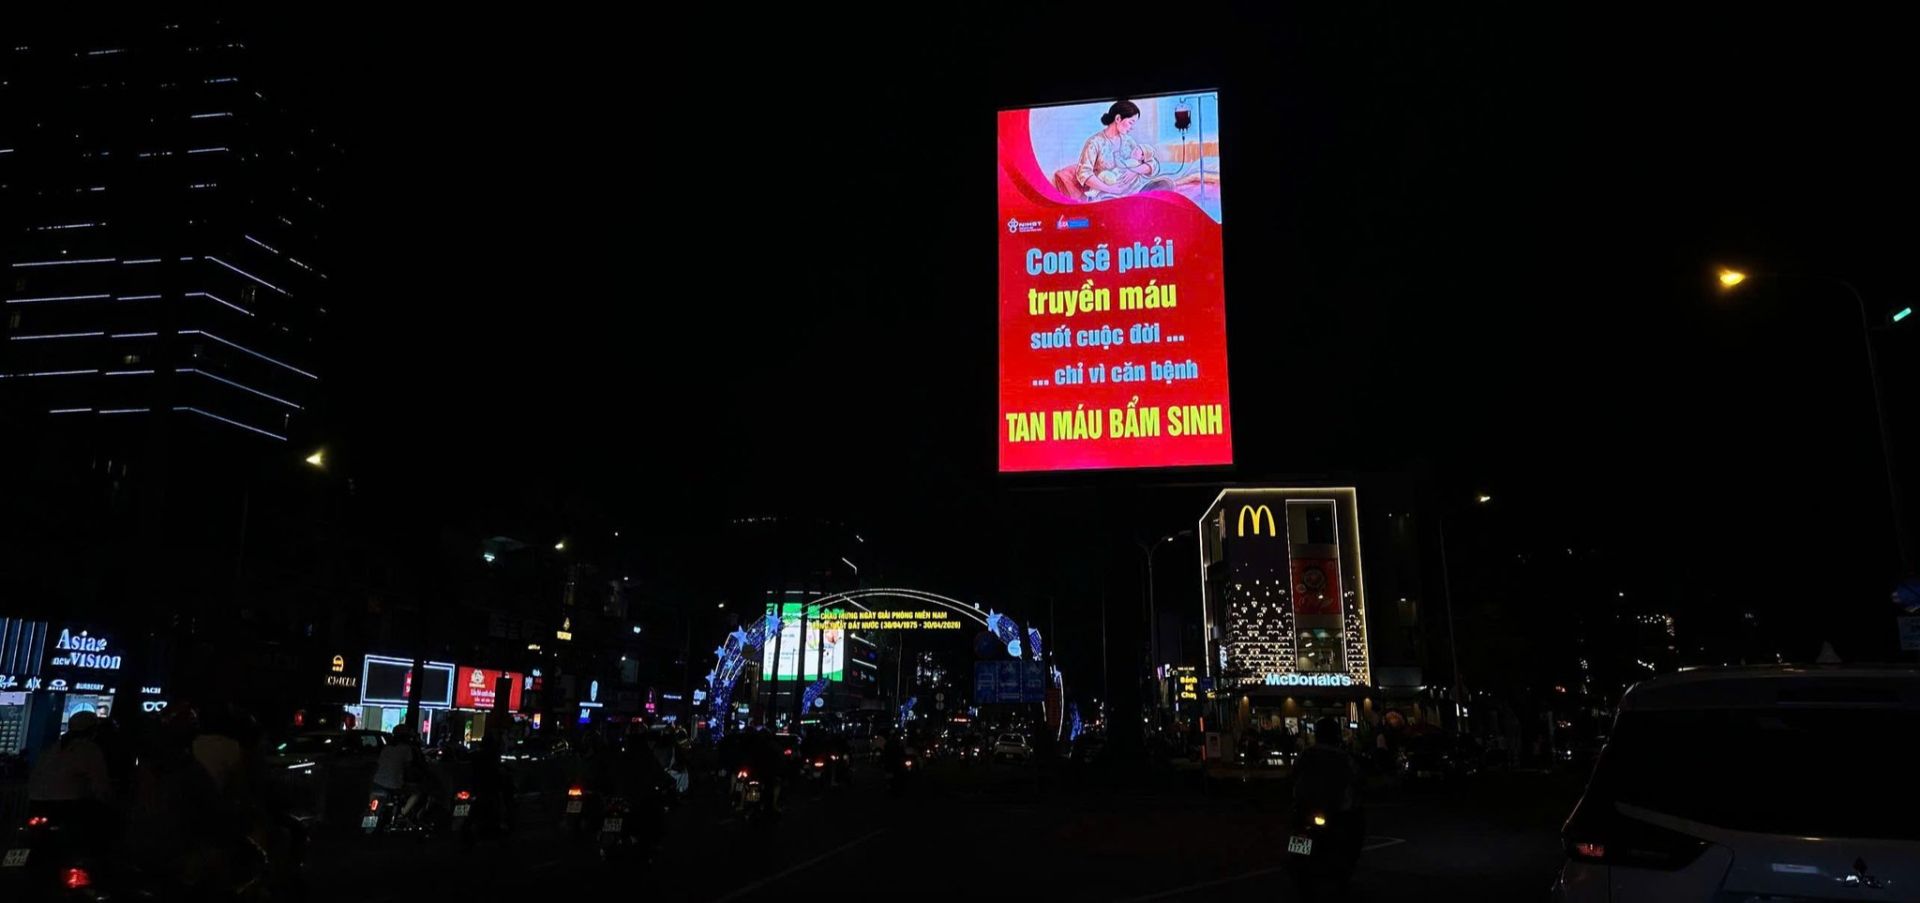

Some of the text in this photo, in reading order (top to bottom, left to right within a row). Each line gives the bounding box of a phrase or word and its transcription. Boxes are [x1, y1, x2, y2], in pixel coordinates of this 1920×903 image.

[1026, 236, 1175, 276] Con sẽ phải
[1028, 280, 1177, 317] truyền máu
[1031, 325, 1072, 350] suốt
[1077, 326, 1124, 351] cuộc
[1130, 323, 1161, 345] đời
[1055, 360, 1083, 385] chỉ
[1088, 361, 1106, 383] vì
[1111, 361, 1145, 383] căn
[1151, 359, 1198, 385] bệnh
[1006, 395, 1223, 442] TAN MÁU BẨM SINH
[932, 611, 947, 619] NAM
[56, 628, 98, 652] Asia
[1265, 672, 1352, 686] McDonald's
